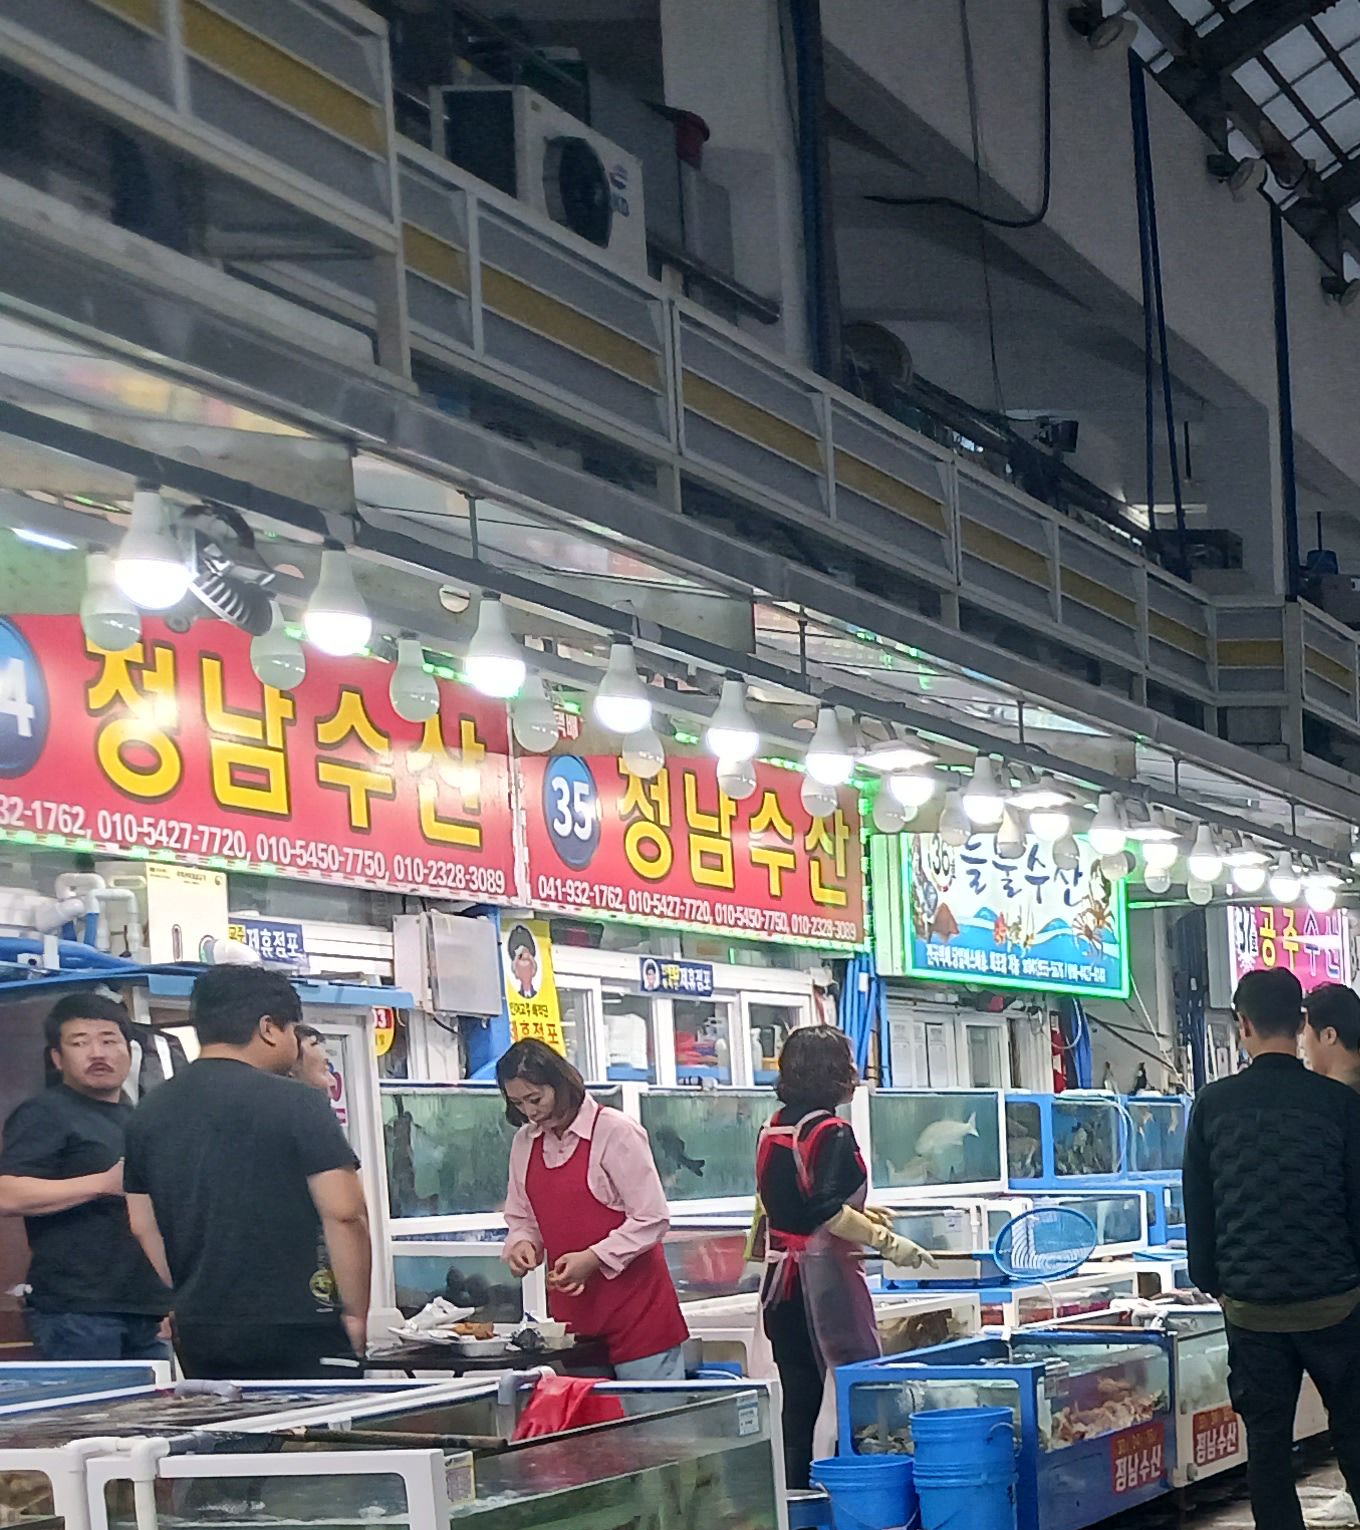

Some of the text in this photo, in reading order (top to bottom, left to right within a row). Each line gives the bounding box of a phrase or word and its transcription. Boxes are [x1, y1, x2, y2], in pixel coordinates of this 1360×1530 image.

[86, 638, 487, 848] 정남수산
[551, 776, 593, 841] 35
[617, 757, 850, 906] 정남수산
[393, 854, 505, 893] 010-2328-3089
[1115, 1444, 1161, 1492] 정남수산
[1196, 1422, 1237, 1463] 정남수산
